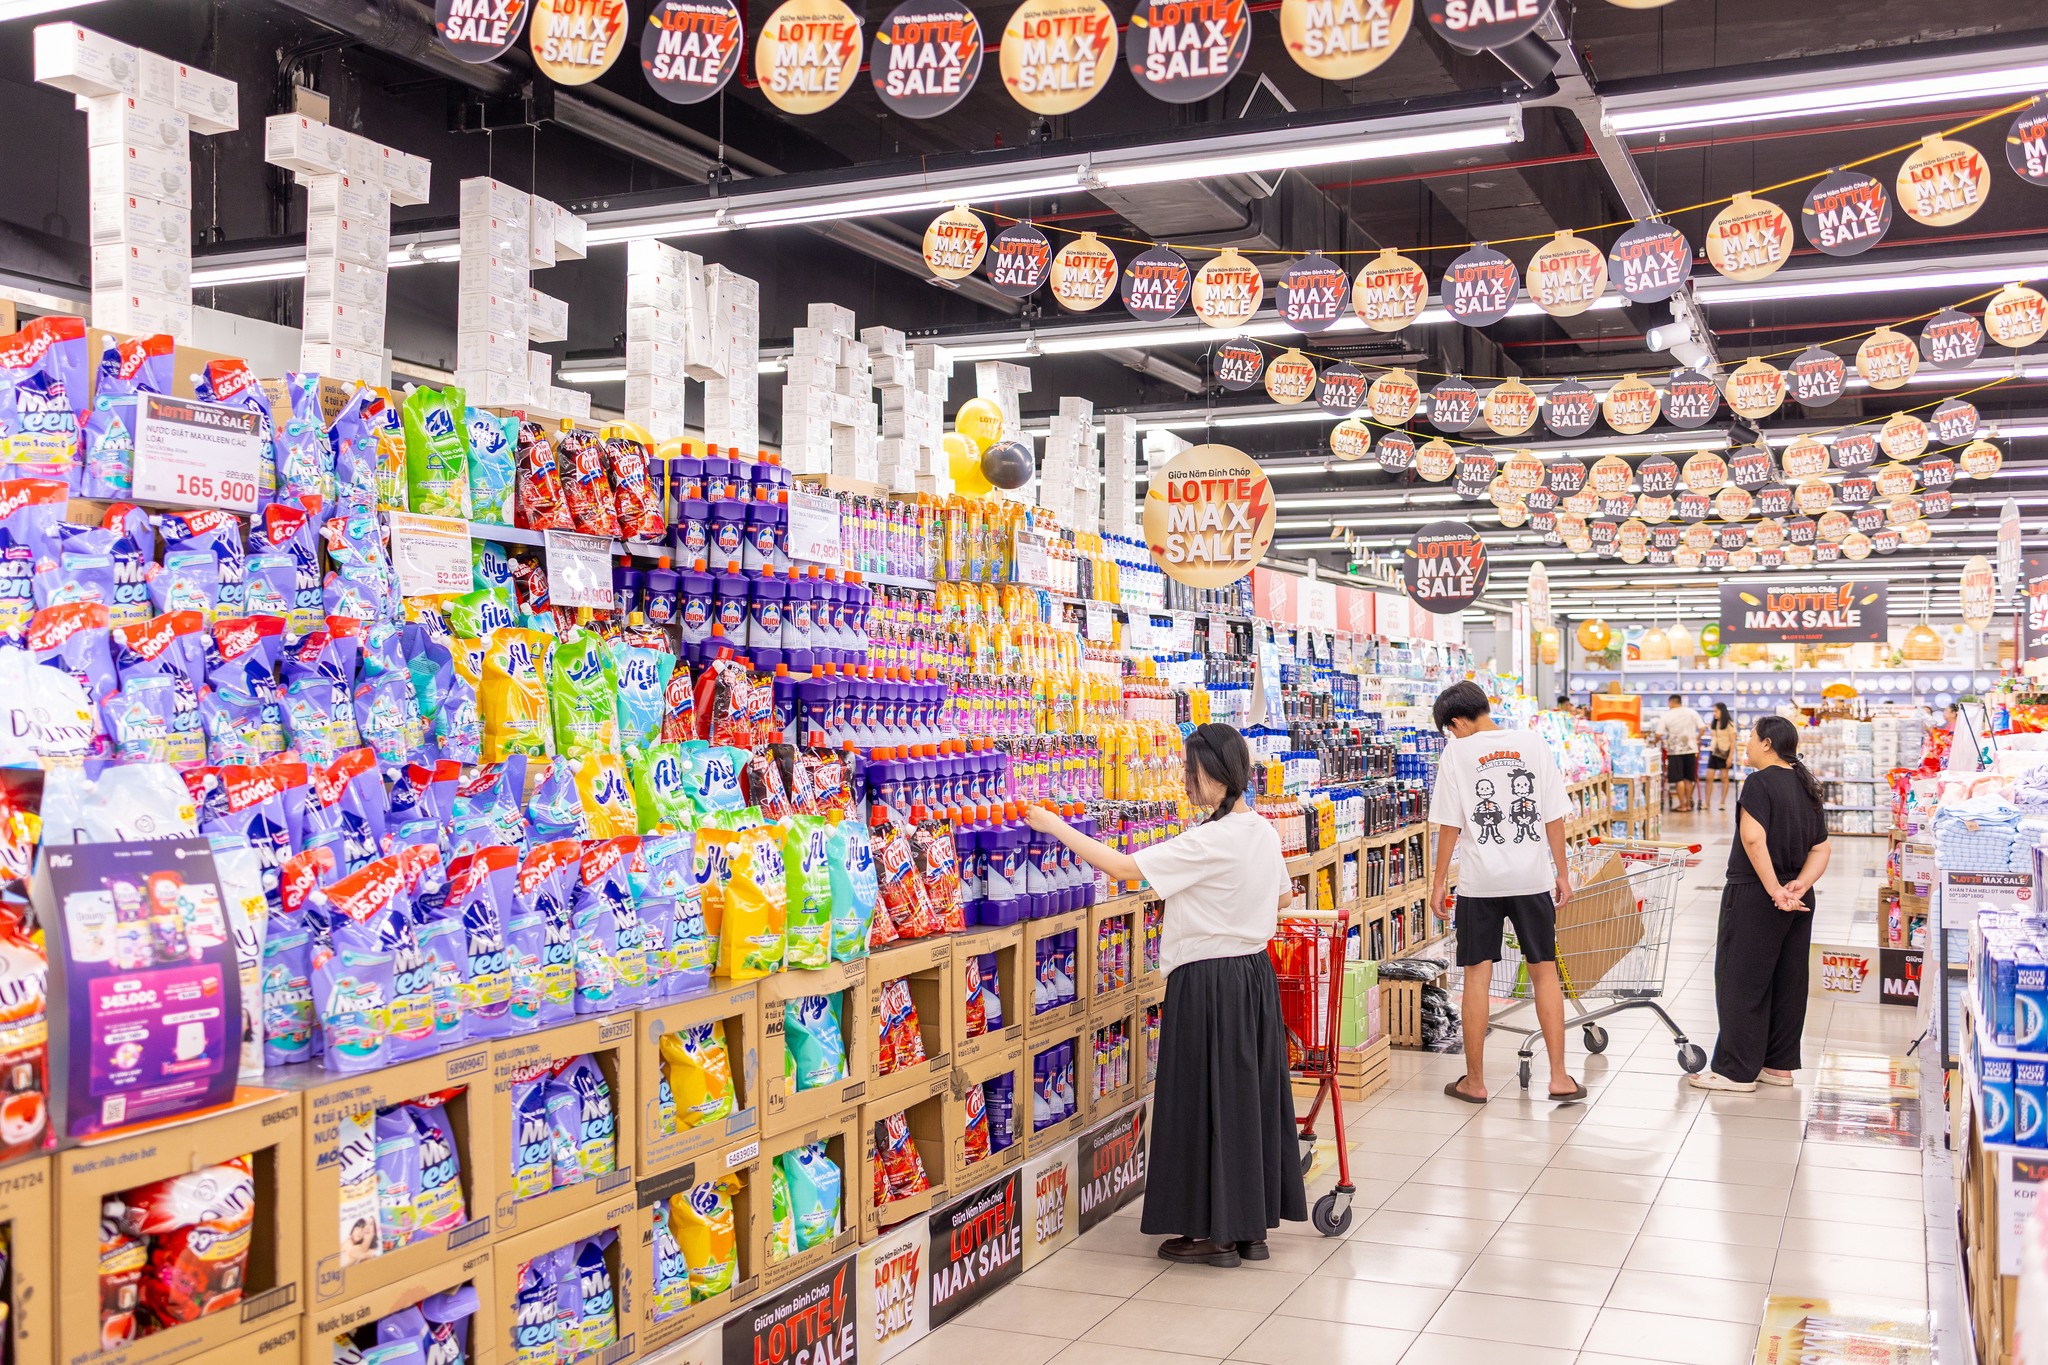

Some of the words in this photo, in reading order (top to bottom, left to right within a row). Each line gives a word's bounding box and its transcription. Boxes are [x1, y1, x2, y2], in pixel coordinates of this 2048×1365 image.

[450, 0, 509, 21] MAX
[553, 0, 613, 17] LOTTE
[1148, 0, 1227, 28] LOTTE
[1306, 0, 1389, 29] MAX
[1445, 0, 1539, 30] SALE
[445, 16, 507, 45] SALE
[548, 15, 609, 41] MAX
[662, 11, 727, 33] LOTTE
[776, 23, 845, 42] LOTTE
[891, 21, 962, 43] LOTTE
[1023, 15, 1097, 39] LOTTE
[657, 29, 724, 59] MAX
[1147, 20, 1227, 53] MAX
[1303, 19, 1391, 58] SALE
[542, 38, 607, 65] SALE
[775, 42, 841, 67] MAX
[888, 41, 962, 69] MAX
[1021, 33, 1095, 67] MAX
[652, 58, 721, 84] SALE
[1146, 46, 1229, 81] SALE
[770, 66, 841, 93] SALE
[886, 67, 961, 95] SALE
[1018, 61, 1096, 94] SALE
[1910, 156, 1969, 184] LOTTE
[1913, 168, 1975, 200] MAX
[1813, 186, 1873, 214] LOTTE
[1917, 186, 1979, 217] SALE
[1817, 200, 1876, 231] MAX
[937, 226, 978, 239] LOTTE
[1820, 222, 1881, 247] SALE
[934, 237, 976, 254] MAX
[1621, 238, 1674, 261] LOTTE
[931, 251, 974, 269] SALE
[1622, 251, 1678, 277] MAX
[1288, 275, 1337, 289] LOTTE
[1454, 266, 1505, 283] LOTTE
[1624, 268, 1679, 293] SALE
[1287, 287, 1337, 304] MAX
[1454, 279, 1506, 299] MAX
[1287, 302, 1336, 320] SALE
[1454, 296, 1506, 315] SALE
[1930, 326, 1970, 339] LOTTE
[1931, 333, 1975, 351] MAX
[1932, 344, 1976, 362] SALE
[1435, 391, 1471, 401] LOTTE
[1435, 399, 1471, 413] MAX
[156, 405, 193, 420] LOTTE
[194, 411, 221, 426] MAX
[222, 416, 251, 430] SALE
[1435, 411, 1470, 423] SALE
[190, 431, 231, 445] MAXKLEEN
[1838, 442, 1873, 456] MAX
[1839, 451, 1874, 465] SALE
[1168, 470, 1188, 480] Giữa
[1188, 470, 1207, 478] Năm
[1208, 468, 1228, 477] Đỉnh
[1229, 467, 1250, 477] Chóp
[176, 474, 255, 503] 165,900
[1168, 478, 1251, 503] LOTTE
[1167, 502, 1251, 533] MAX
[719, 537, 738, 547] DUCK
[1166, 532, 1252, 563] SALE
[1417, 540, 1473, 559] LOTTE
[1417, 556, 1473, 578] MAX
[1416, 576, 1474, 598] SALE
[1766, 593, 1839, 612] LOTTE
[650, 610, 668, 619] DUCK
[762, 616, 780, 626] DUCK
[1744, 611, 1799, 629] MAX
[1801, 609, 1861, 628] SALE
[1822, 956, 1861, 967] LOTTE
[1822, 965, 1861, 979] MAX
[1822, 976, 1862, 991] SALE
[2018, 970, 2046, 978] WHITE
[2018, 976, 2045, 986] NOW
[1883, 978, 1920, 996] MA
[601, 1024, 631, 1039] 68912975
[449, 1056, 485, 1076] 68909047
[1984, 1061, 2012, 1070] WHITE
[1985, 1068, 2012, 1078] NOW
[2017, 1064, 2045, 1072] WHITE
[2017, 1070, 2045, 1080] NOW
[1093, 1132, 1133, 1179] LOTTE
[1036, 1168, 1063, 1199] LOTTE
[1080, 1171, 1111, 1215] MAX
[1113, 1151, 1145, 1194] SALE
[1036, 1185, 1064, 1220] MAX
[950, 1202, 1004, 1262] LOTTE
[1035, 1207, 1064, 1242] SALE
[875, 1251, 913, 1289] LOTTE
[932, 1251, 976, 1306] MAX
[978, 1225, 1021, 1277] SALE
[875, 1270, 913, 1314] MAX
[754, 1315, 775, 1332] Giữa
[774, 1305, 793, 1322] Năm
[792, 1295, 811, 1313] Đỉnh
[811, 1283, 830, 1302] Chóp
[874, 1295, 913, 1341] SALE
[754, 1296, 832, 1365] LOTTE
